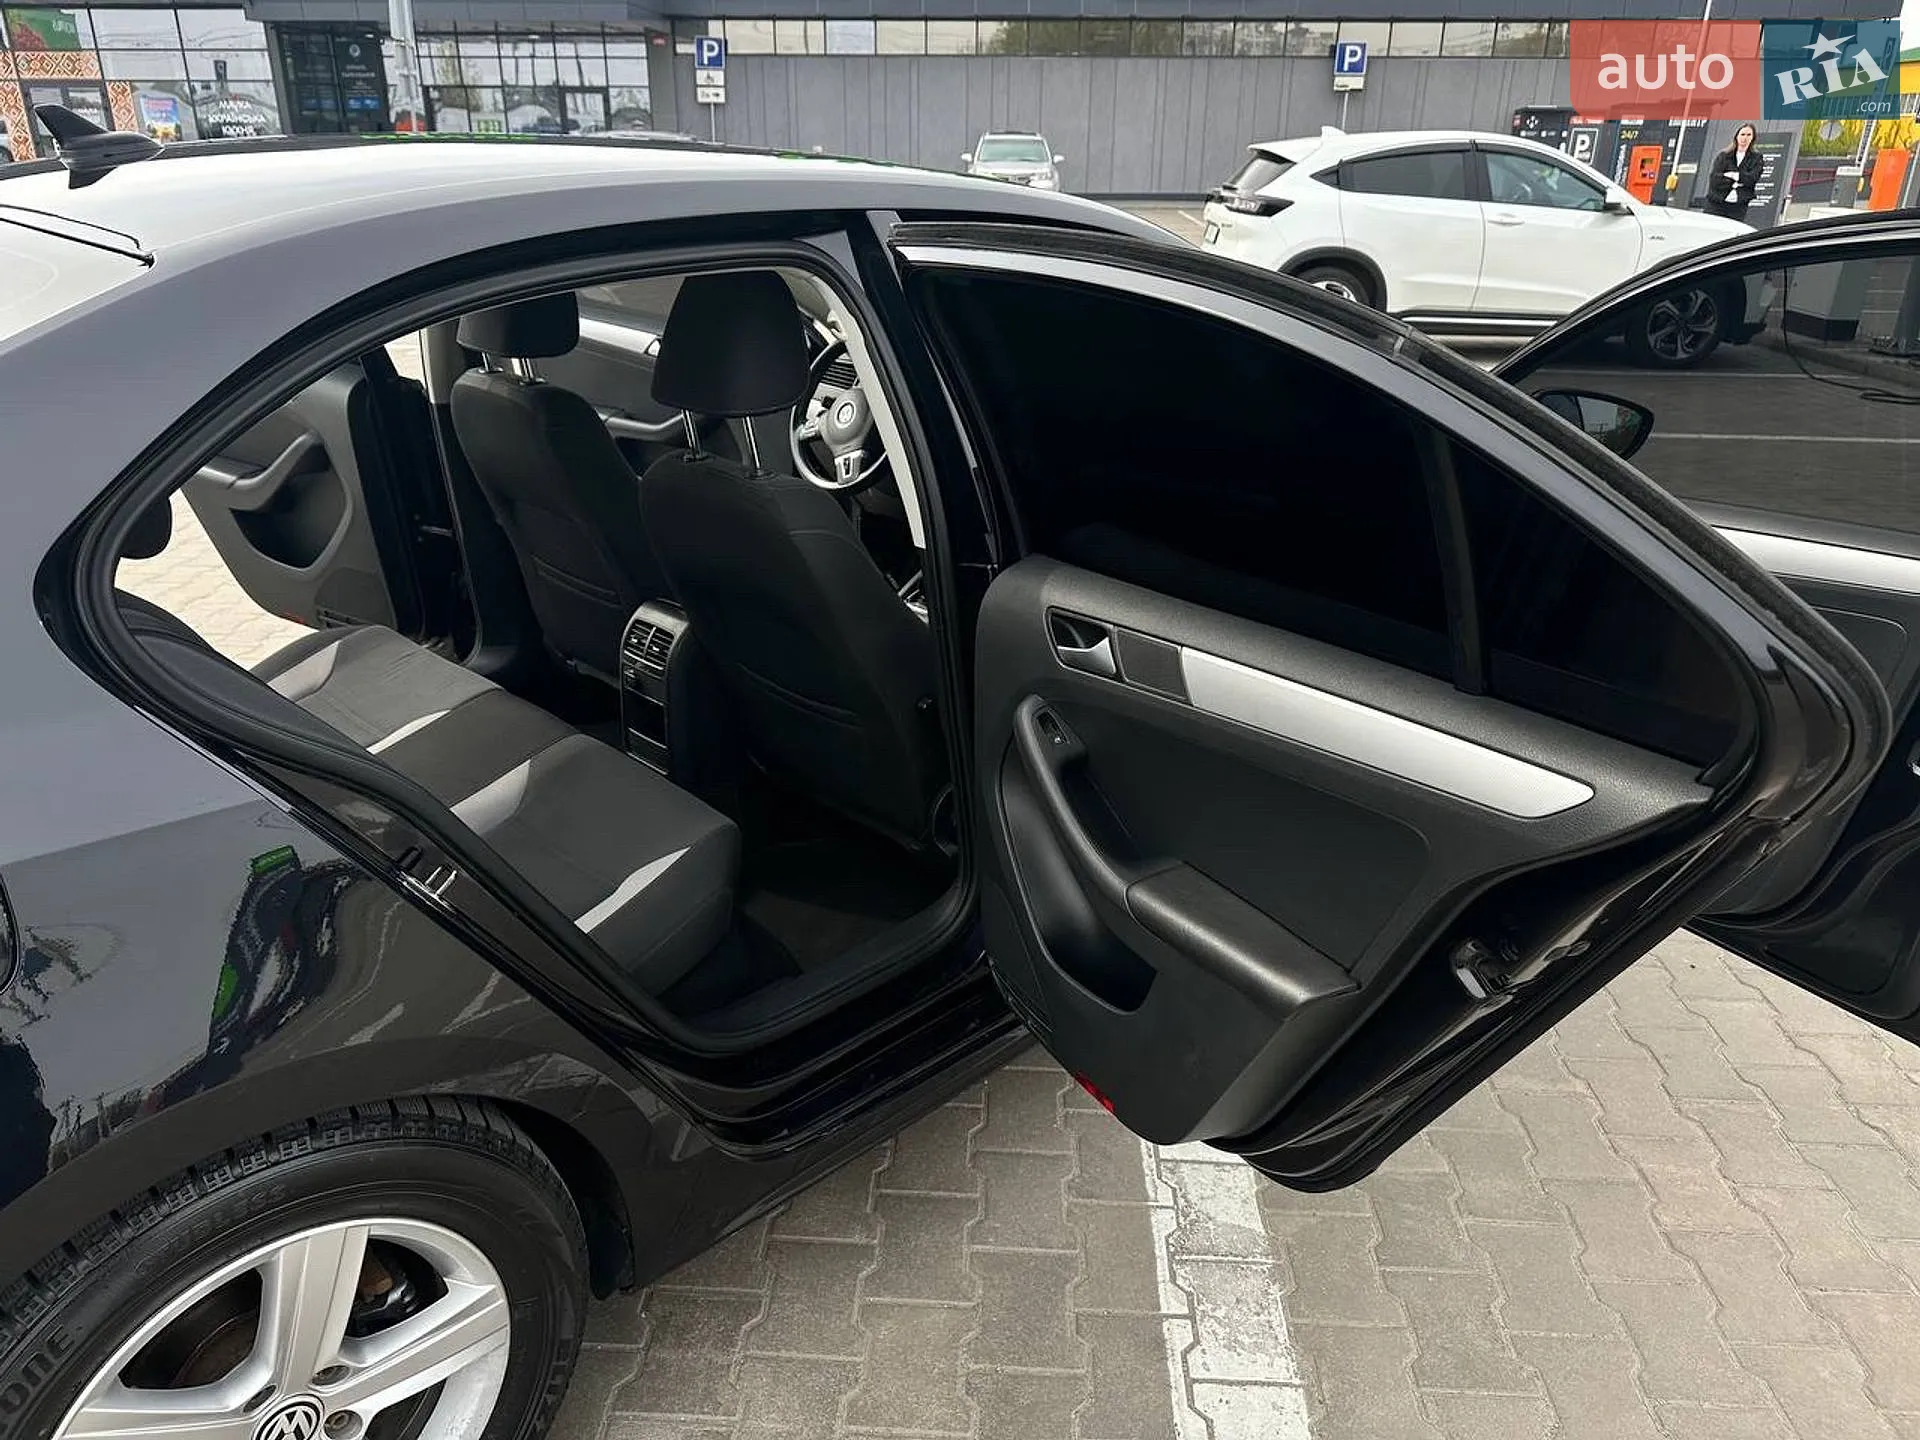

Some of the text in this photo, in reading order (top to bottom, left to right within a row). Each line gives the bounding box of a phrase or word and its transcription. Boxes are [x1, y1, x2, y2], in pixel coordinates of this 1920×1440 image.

[702, 39, 719, 64] P
[1343, 45, 1362, 71] P
[1574, 134, 1590, 159] P
[0, 1324, 75, 1430] ONE
